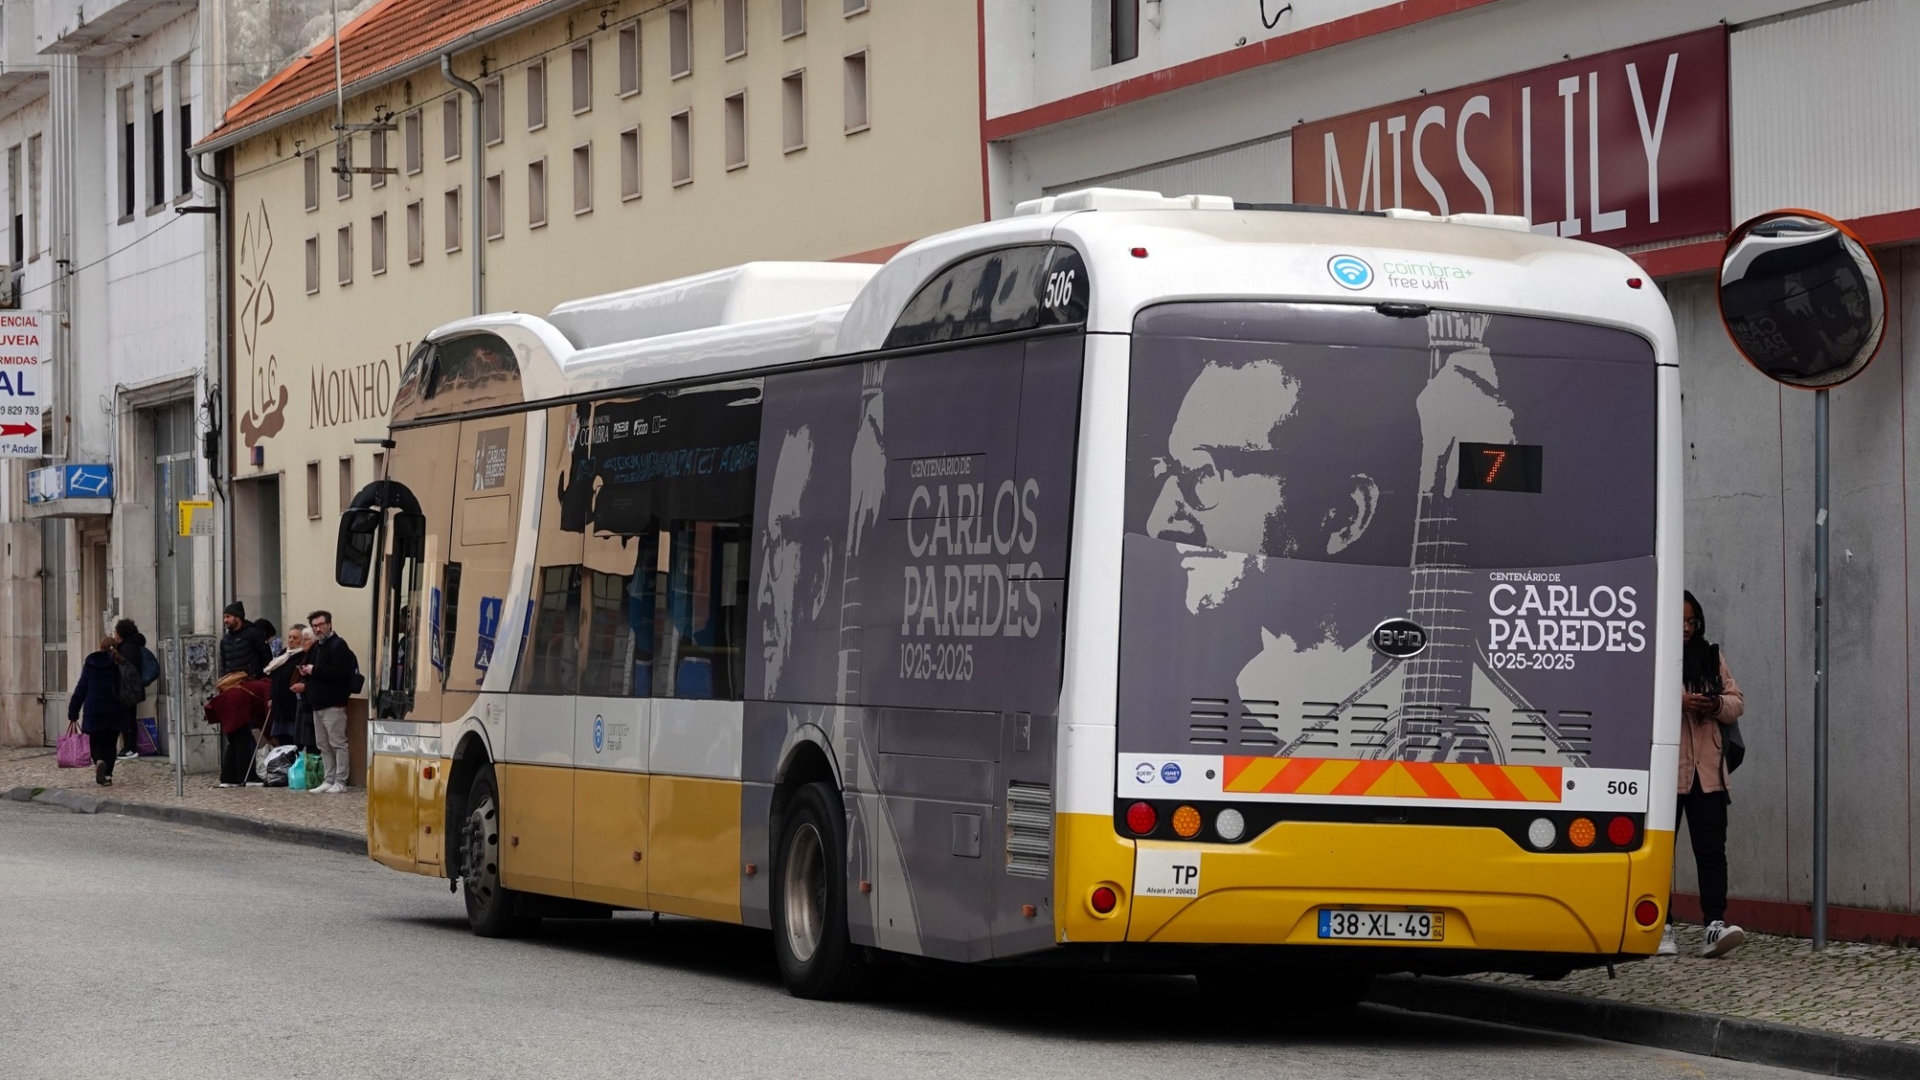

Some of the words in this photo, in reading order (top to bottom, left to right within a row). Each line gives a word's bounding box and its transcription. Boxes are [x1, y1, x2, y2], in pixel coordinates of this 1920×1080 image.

[1324, 95, 1495, 216] MISS
[1522, 53, 1679, 238] LILY
[1383, 260, 1473, 279] coimbra+
[1388, 274, 1418, 289] free
[1421, 277, 1449, 290] wifi
[1045, 269, 1075, 308] 506
[0, 371, 35, 396] AL
[309, 359, 391, 429] MOINHO
[7, 406, 22, 415] 829
[25, 406, 39, 415] 793
[580, 425, 609, 446] COMBRA
[12, 444, 38, 453] Andar
[911, 452, 960, 478] CENTENÁRIO
[960, 457, 971, 474] DE
[1483, 451, 1505, 483] 7
[907, 478, 1040, 557] CARLOS
[1489, 570, 1548, 581] CENTENÁRIO
[1548, 573, 1561, 582] DE
[901, 561, 1044, 638] PAREDES
[1489, 583, 1637, 618] CARLOS
[1379, 630, 1421, 647] BYD
[1488, 618, 1646, 652] PAREDES
[900, 643, 974, 681] 1925-2025
[1488, 652, 1575, 669] 1925-2025
[1607, 781, 1638, 795] 506
[1172, 865, 1198, 885] TP
